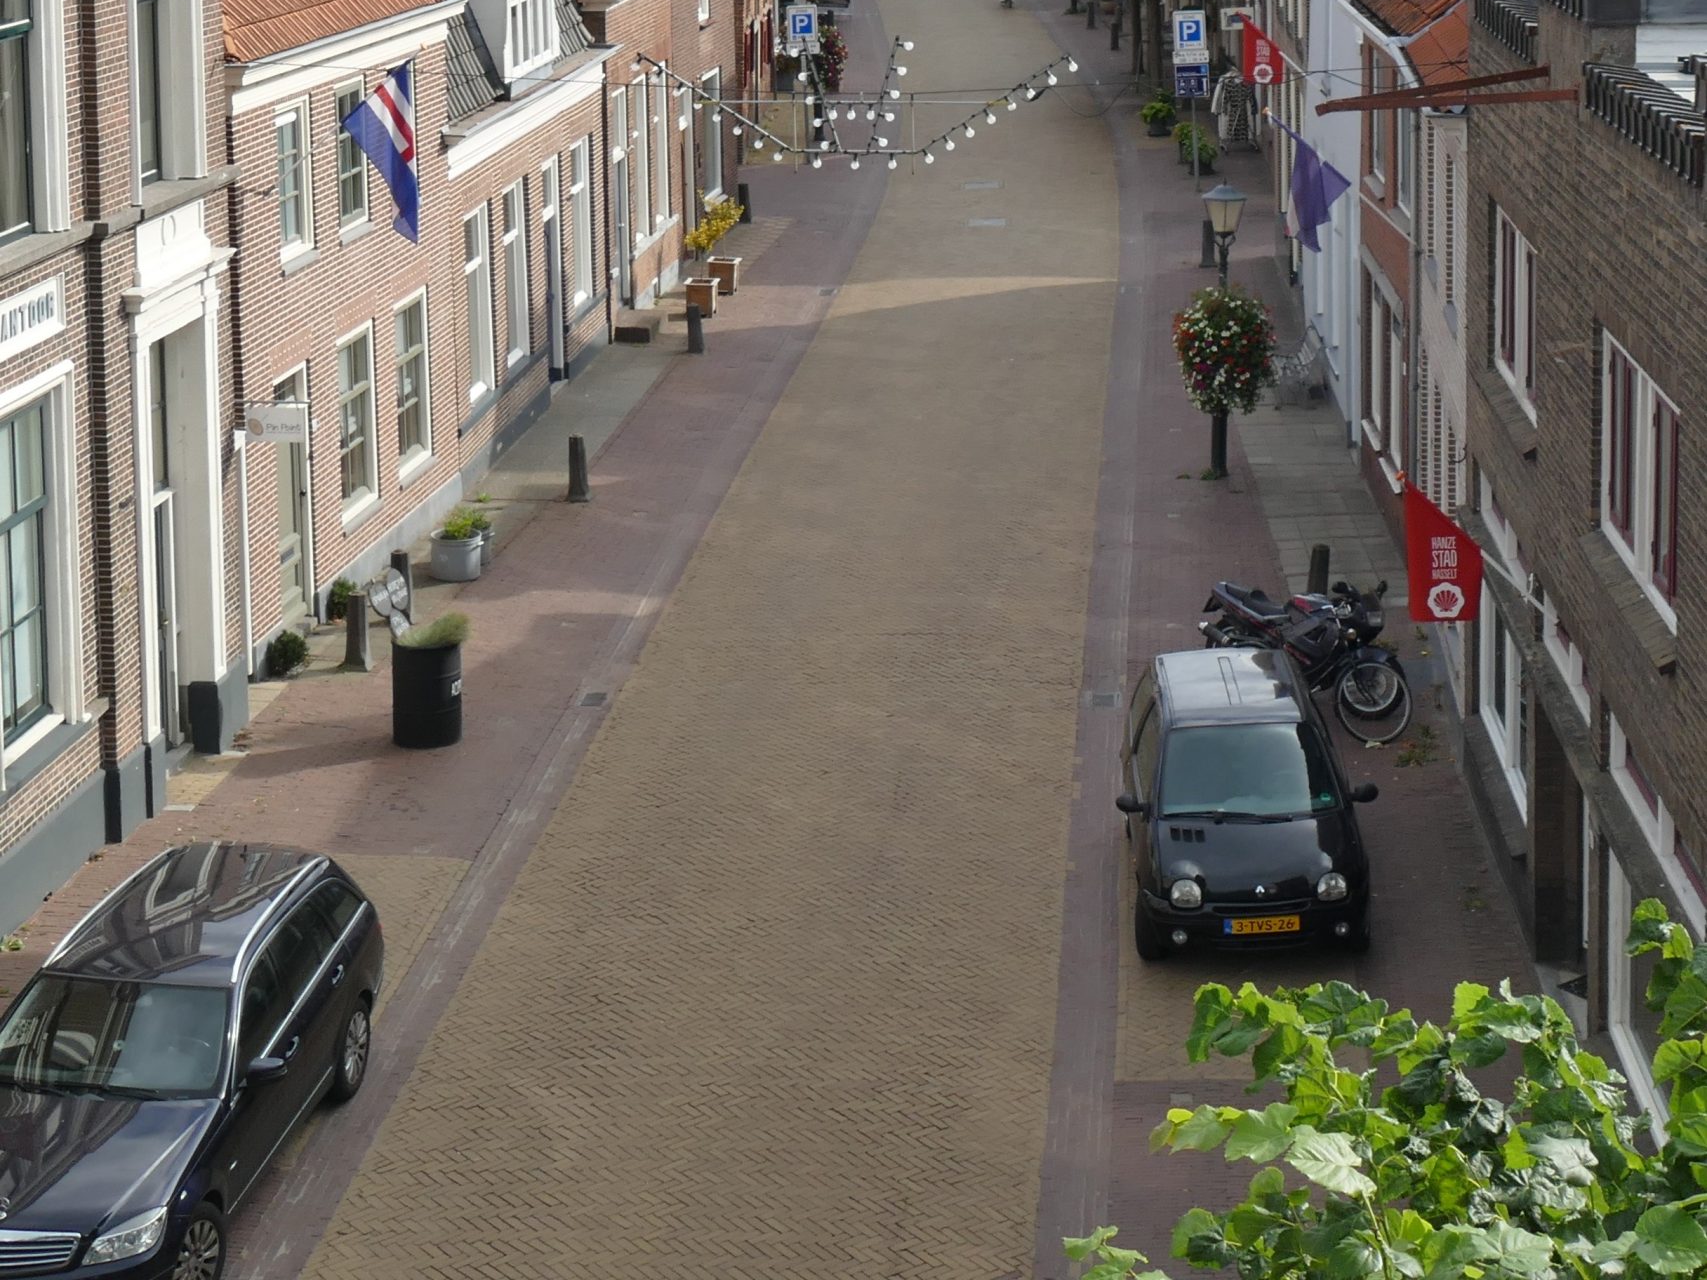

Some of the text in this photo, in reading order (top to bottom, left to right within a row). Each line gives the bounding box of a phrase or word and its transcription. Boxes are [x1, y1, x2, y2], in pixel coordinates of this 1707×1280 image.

[795, 15, 809, 33] P
[1182, 21, 1197, 41] P
[1431, 536, 1457, 549] HANZE
[1431, 550, 1457, 568] STAD
[1236, 919, 1295, 932] 3-TVS-26
